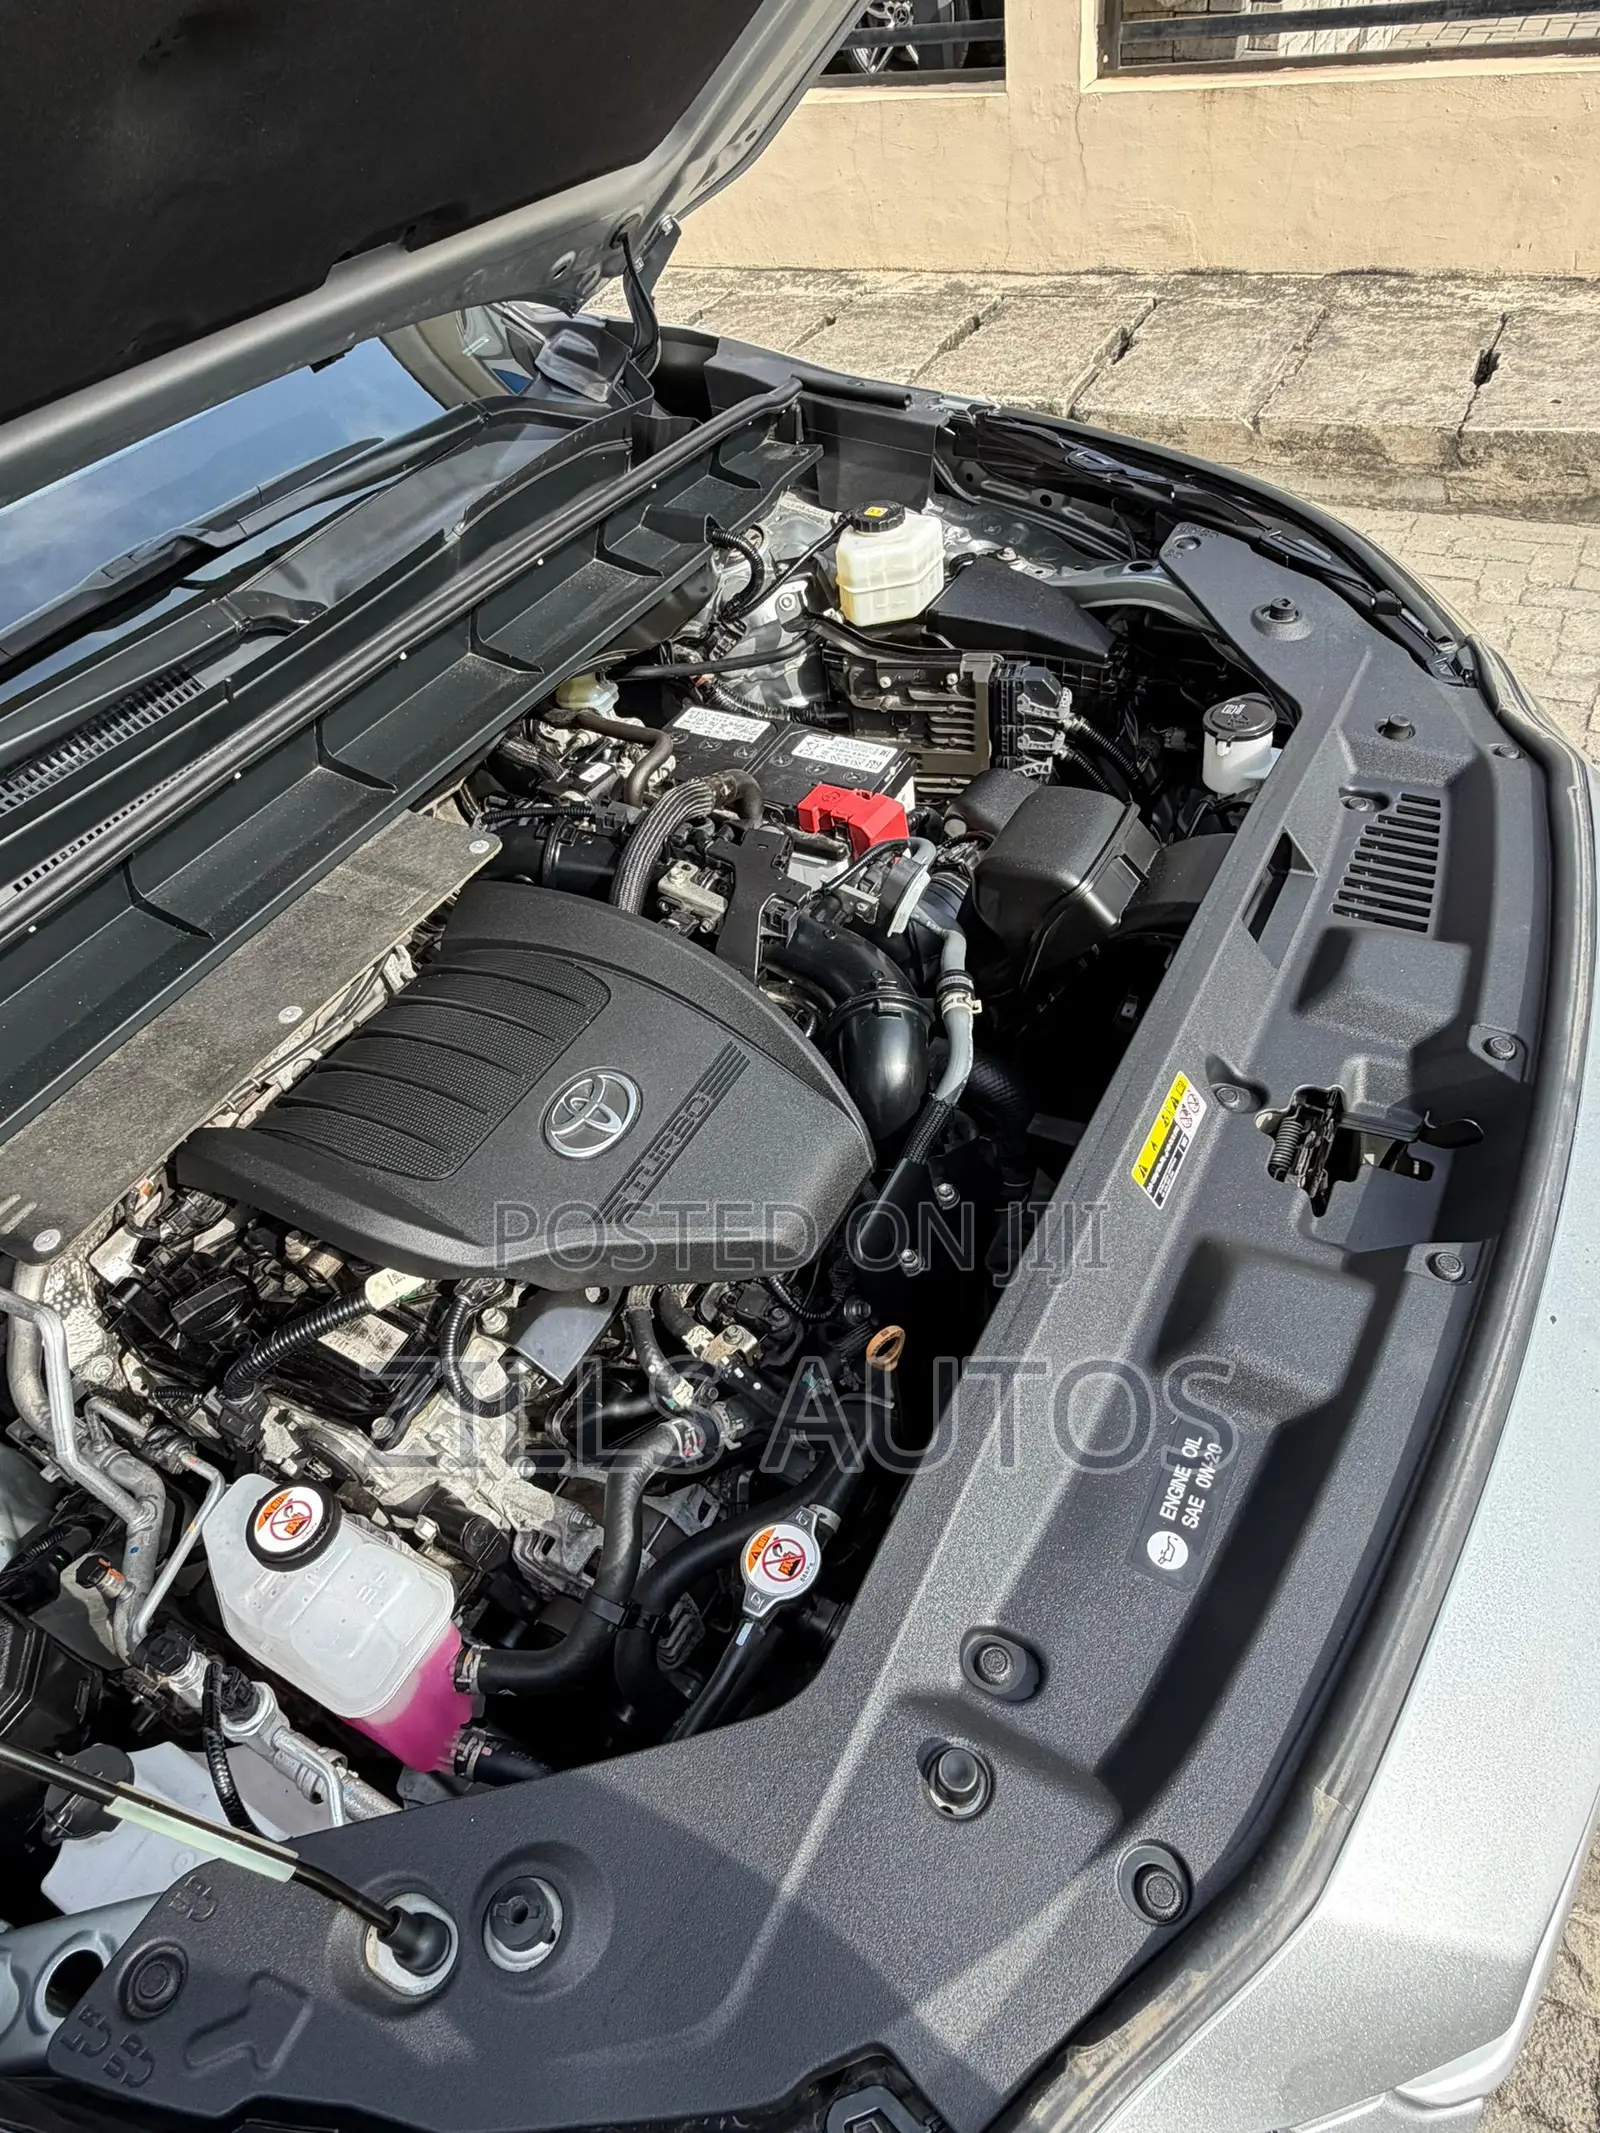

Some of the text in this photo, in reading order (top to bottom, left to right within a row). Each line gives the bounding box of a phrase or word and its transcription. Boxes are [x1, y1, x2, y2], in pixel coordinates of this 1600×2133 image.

[1159, 1436, 1203, 1521] ENGINE OIL
[1181, 1442, 1223, 1529] SAE 0W-20
